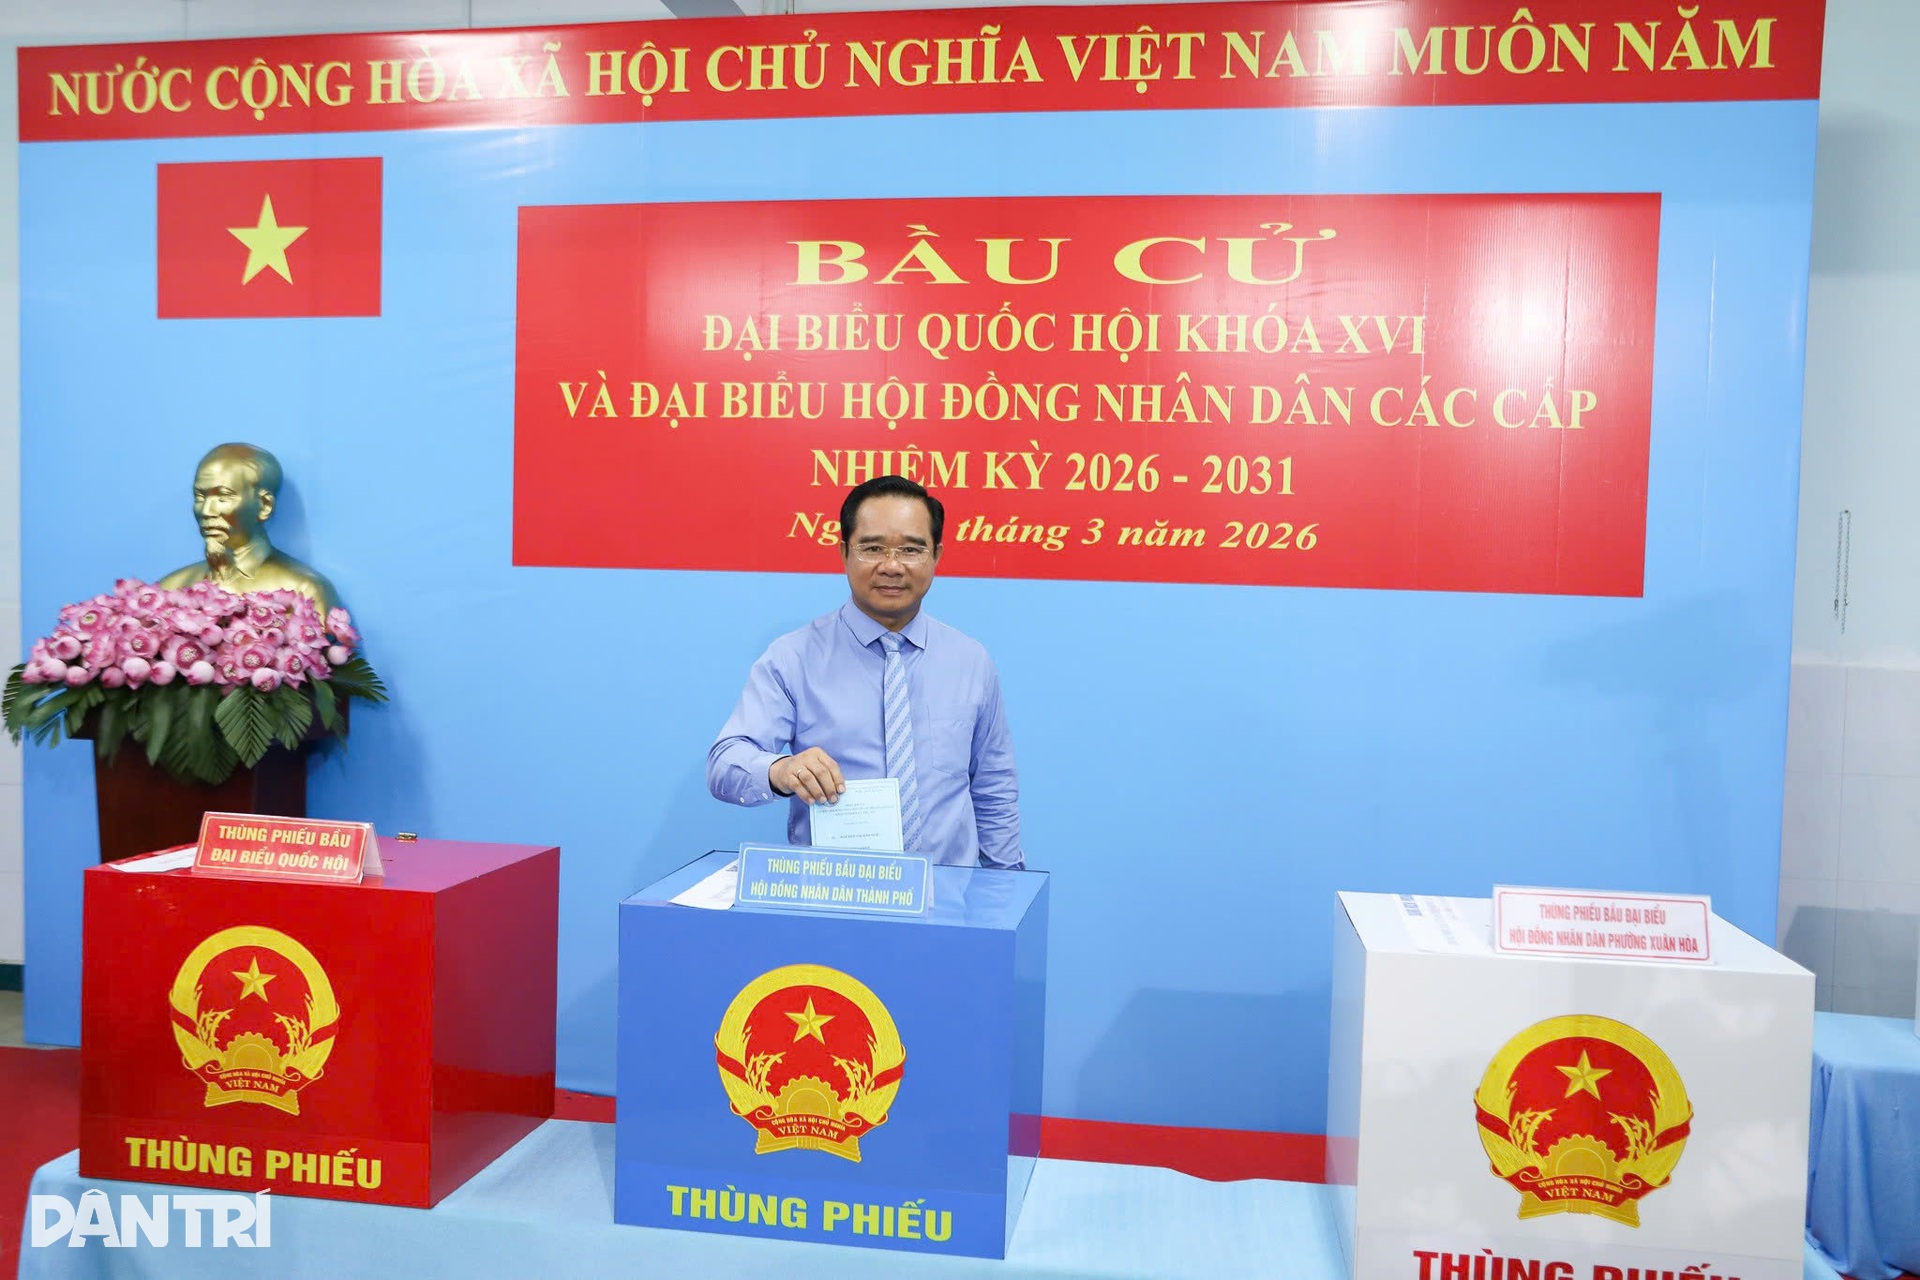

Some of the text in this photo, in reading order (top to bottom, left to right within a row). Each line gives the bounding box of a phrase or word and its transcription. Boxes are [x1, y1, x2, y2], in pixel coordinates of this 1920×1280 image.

[48, 6, 1778, 122] NƯỚC CỘNG HÒA XÃ HỘI CHỦ NGHĨA VIỆT NAM MUÔN NĂM
[787, 222, 1336, 285] BẦU CỬ
[703, 301, 1426, 363] ĐẠI BIỂU QUỐC HỘI KHÓA XVI
[559, 370, 1598, 430] VÀ ĐẠI BIỂU HỘI ĐỒNG NHÂN DÂN CÁC CẤP
[982, 440, 1053, 490] KỲ
[1065, 453, 1160, 492] 2026
[1172, 475, 1188, 484] -
[1201, 455, 1296, 496] 2031
[786, 512, 1320, 551] Ng tháng 3 năm 2026
[219, 824, 351, 848] THÙNG PHIẾU BẦU
[210, 848, 236, 865] ĐẠI
[239, 846, 275, 865] BIỂU
[278, 850, 319, 868] QUỐC
[322, 856, 349, 874] HỘI
[767, 856, 902, 882] THÙNG PHIẾU BẦU ĐẠI BIỂU
[751, 881, 767, 899] HỘI
[770, 879, 798, 899] ĐỒNG
[801, 882, 829, 900] NHÂN
[832, 884, 853, 902] DÂN
[856, 886, 889, 904] THÀNH
[892, 887, 914, 906] PHỐ
[1539, 903, 1571, 920] THÙNG
[1573, 902, 1600, 922] PHIẾU
[1625, 908, 1641, 926] ĐẠI
[1556, 928, 1582, 947] NHÂN
[1586, 930, 1605, 948] DÂN
[1608, 931, 1647, 950] PHƯỜNG
[1649, 934, 1676, 952] XUÂN
[1679, 934, 1699, 953] HÒA
[225, 1078, 251, 1088] VIỆT
[253, 1081, 280, 1092] NAM
[778, 1124, 838, 1139] VIỆT NAM
[125, 1134, 383, 1190] THÙNG PHIẾU
[1545, 1186, 1615, 1202] VIỆT NAM
[667, 1184, 953, 1243] THÙNG PHIẾU
